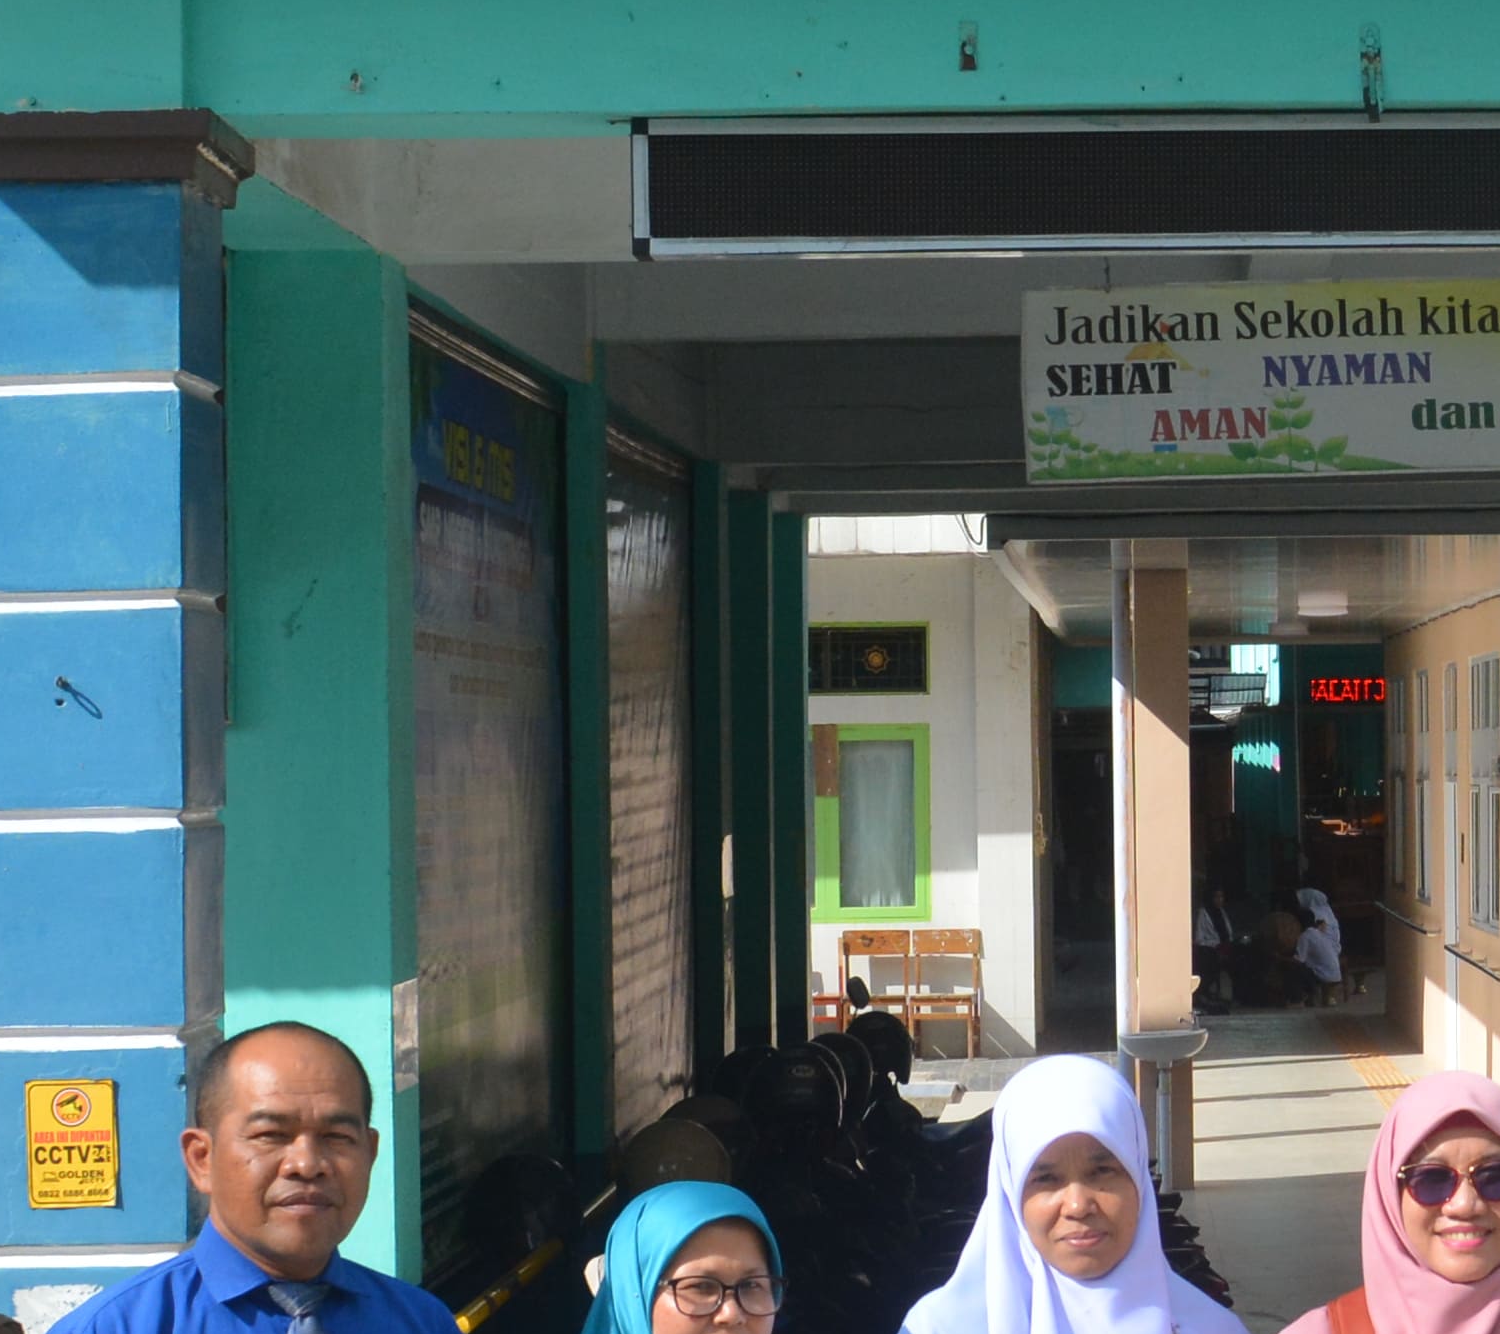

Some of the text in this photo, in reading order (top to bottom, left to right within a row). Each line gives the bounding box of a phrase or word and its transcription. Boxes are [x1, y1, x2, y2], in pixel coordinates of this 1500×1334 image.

[1045, 302, 1220, 346] Jadikan
[1236, 296, 1405, 340] Sekolah
[1046, 351, 1432, 398] SEHAT NYAMAN
[1150, 405, 1267, 442] AMAN
[1411, 398, 1495, 431] dan
[34, 1146, 91, 1165] CCTV
[58, 1170, 104, 1179] GOLDEN
